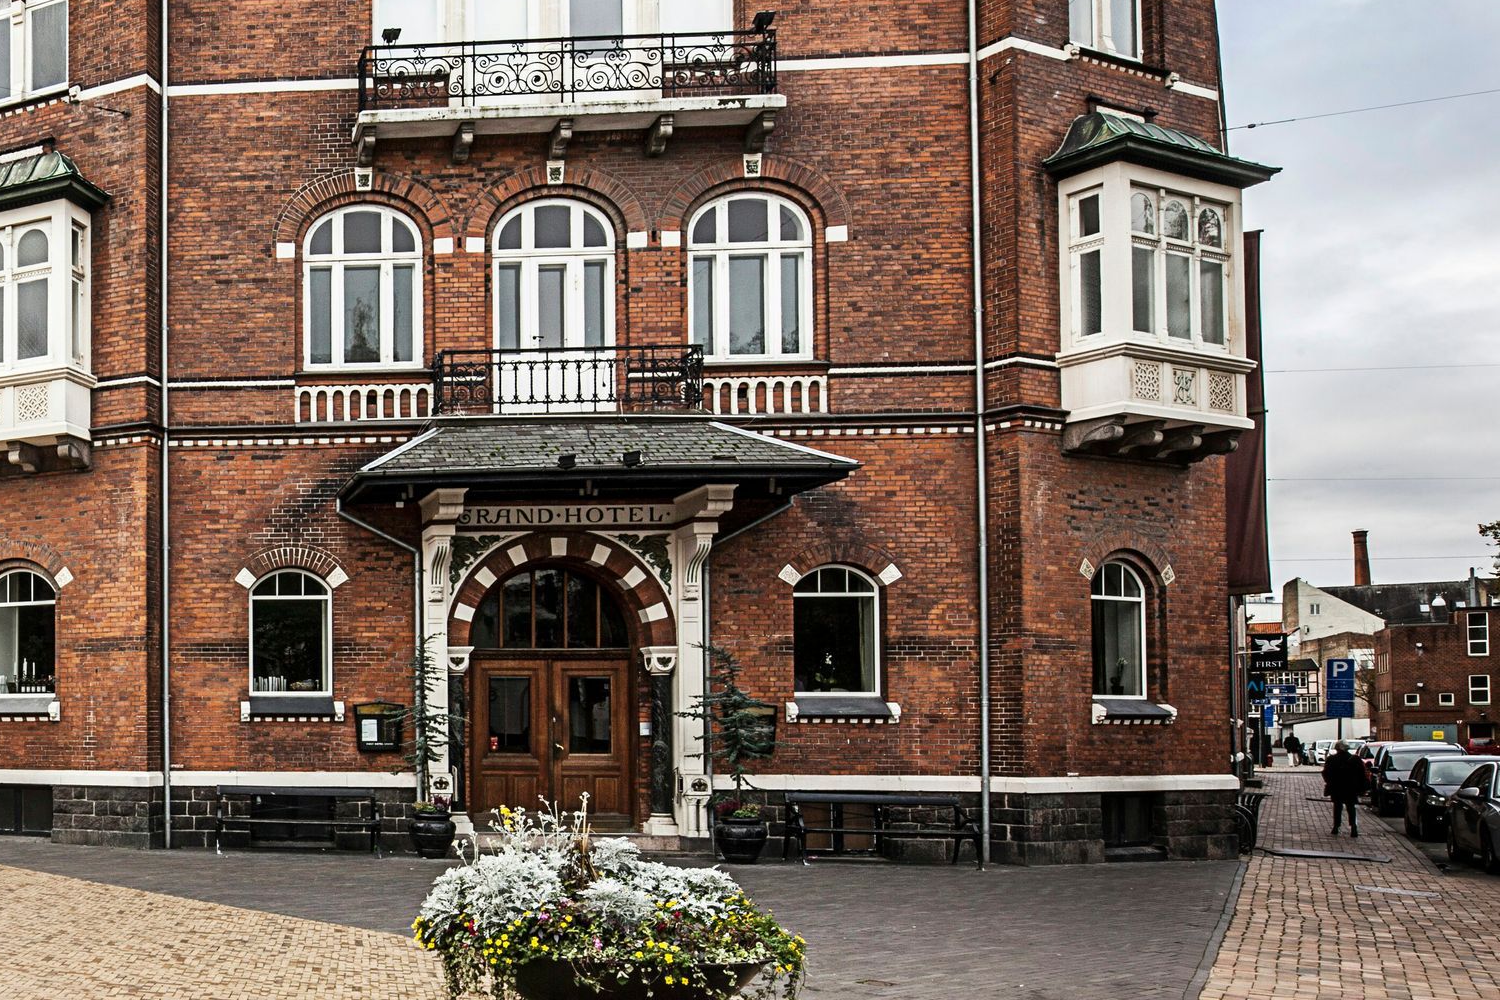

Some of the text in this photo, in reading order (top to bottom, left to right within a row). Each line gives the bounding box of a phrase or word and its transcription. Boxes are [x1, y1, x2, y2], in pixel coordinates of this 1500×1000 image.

[564, 506, 664, 523] HOTEL
[1255, 660, 1283, 668] FIRST
[1332, 661, 1349, 678] P
